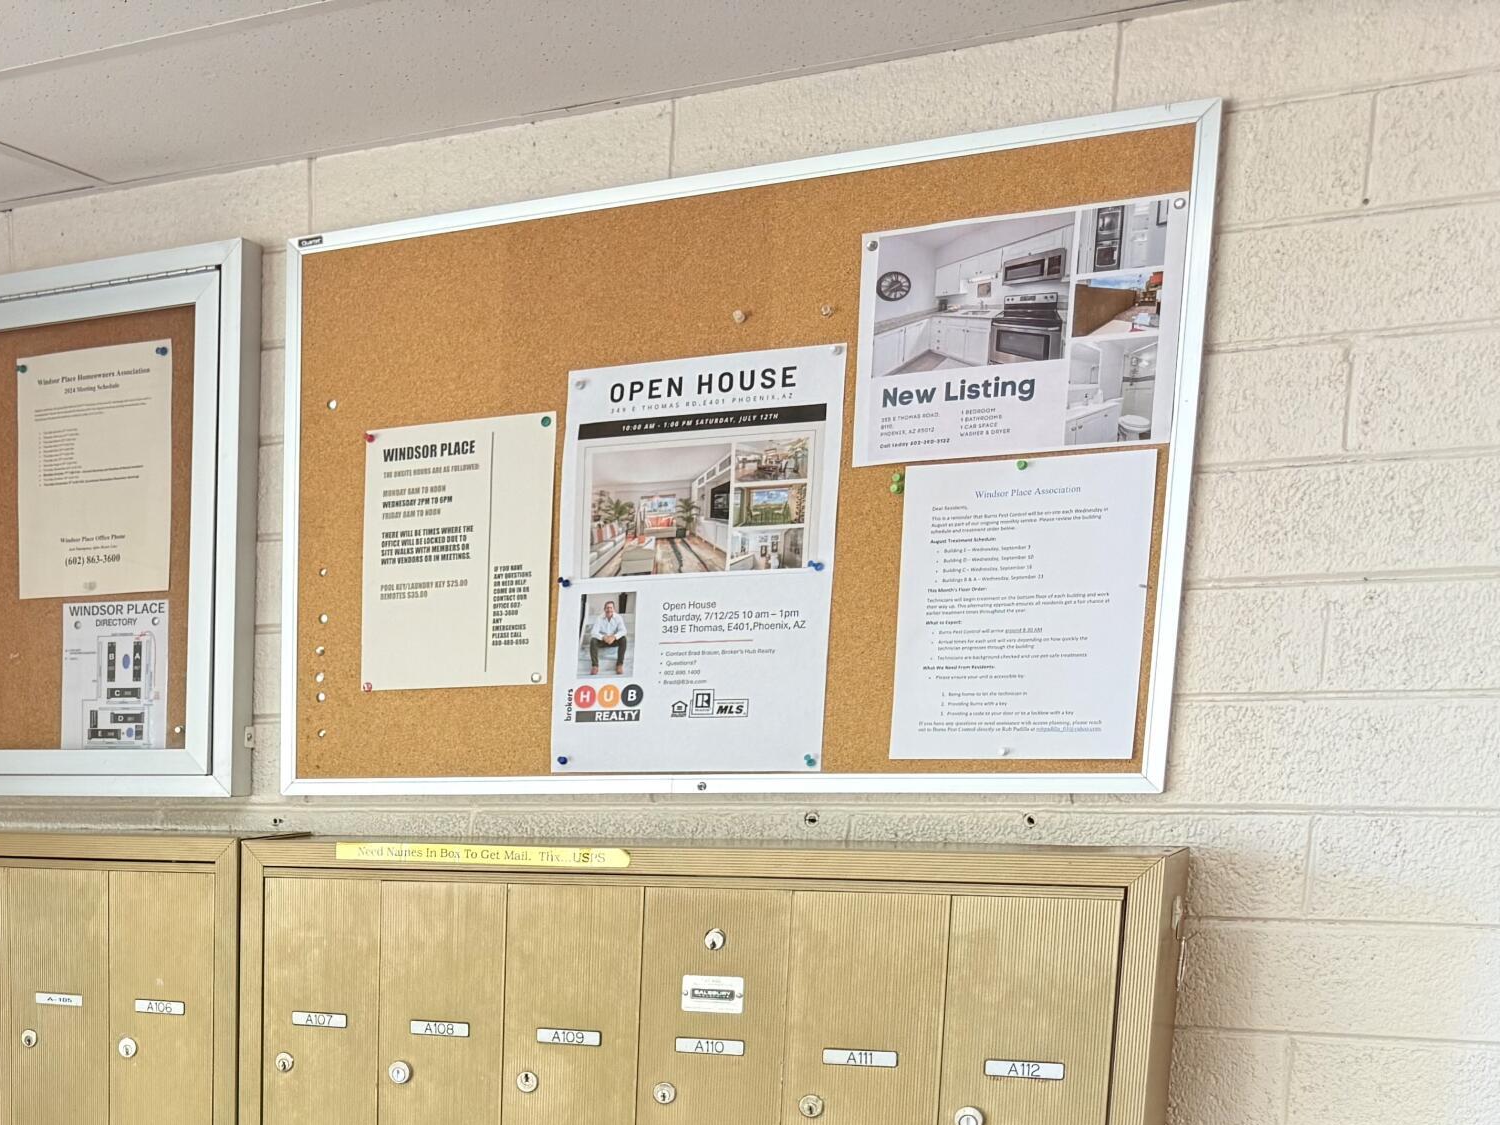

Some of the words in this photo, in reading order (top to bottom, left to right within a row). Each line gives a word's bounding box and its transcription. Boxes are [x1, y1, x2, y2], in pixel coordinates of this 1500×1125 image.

[37, 378, 60, 386] Windsor
[61, 376, 76, 384] Place
[78, 372, 115, 381] Homeowners
[117, 367, 150, 377] Association
[77, 385, 96, 393] Meeting
[610, 376, 684, 403] OPEN
[697, 366, 798, 394] HOUSE
[882, 387, 936, 408] New
[944, 376, 1036, 402] Listing
[641, 401, 680, 411] THOMAS
[644, 422, 655, 430] AM
[681, 419, 693, 427] PM
[738, 414, 758, 424] JULY
[760, 413, 779, 421] 12TH
[383, 446, 437, 462] WINDSOR
[441, 440, 475, 457] PLACE
[975, 489, 1009, 500] Windsor
[1011, 488, 1032, 497] Place
[1034, 485, 1081, 495] Association
[382, 499, 416, 509] WEDNESDAY
[417, 498, 430, 506] 2PM
[423, 528, 440, 536] TIMES
[441, 526, 461, 535] WHERE
[381, 540, 400, 548] OFFICE
[415, 546, 430, 554] WITH
[432, 544, 460, 552] MEMBERS
[65, 556, 85, 567] (602)
[86, 554, 120, 564] 863-3600
[398, 556, 423, 564] VENDORS
[69, 605, 123, 616] WINDSOR
[127, 603, 165, 614] PLACE
[663, 601, 686, 612] Open
[688, 599, 716, 610] House
[96, 618, 137, 627] DIRECTORY
[662, 611, 702, 623] Saturday,
[704, 610, 740, 621] 7/12/25
[742, 610, 753, 619] 10
[755, 611, 770, 619] am
[779, 608, 799, 620] 1pm
[662, 623, 679, 634] 349
[681, 623, 687, 633] E
[689, 622, 725, 634] Thomas,
[794, 619, 806, 629] AZ
[577, 687, 640, 706] HUB
[564, 688, 573, 721] brokers
[716, 704, 745, 715] MLS
[595, 710, 638, 721] REALTY
[357, 847, 383, 857] Need
[386, 847, 423, 858] Names
[426, 848, 437, 858] In
[440, 848, 461, 858] Box
[464, 849, 478, 859] To
[480, 850, 500, 860] Get
[504, 850, 532, 861] Mail.
[146, 1001, 172, 1013] A106
[305, 1014, 334, 1026] A107
[424, 1022, 455, 1036] A108
[551, 1030, 585, 1044] A109
[694, 1039, 725, 1054] A110
[846, 1050, 874, 1066] A111
[1007, 1062, 1041, 1078] A112
